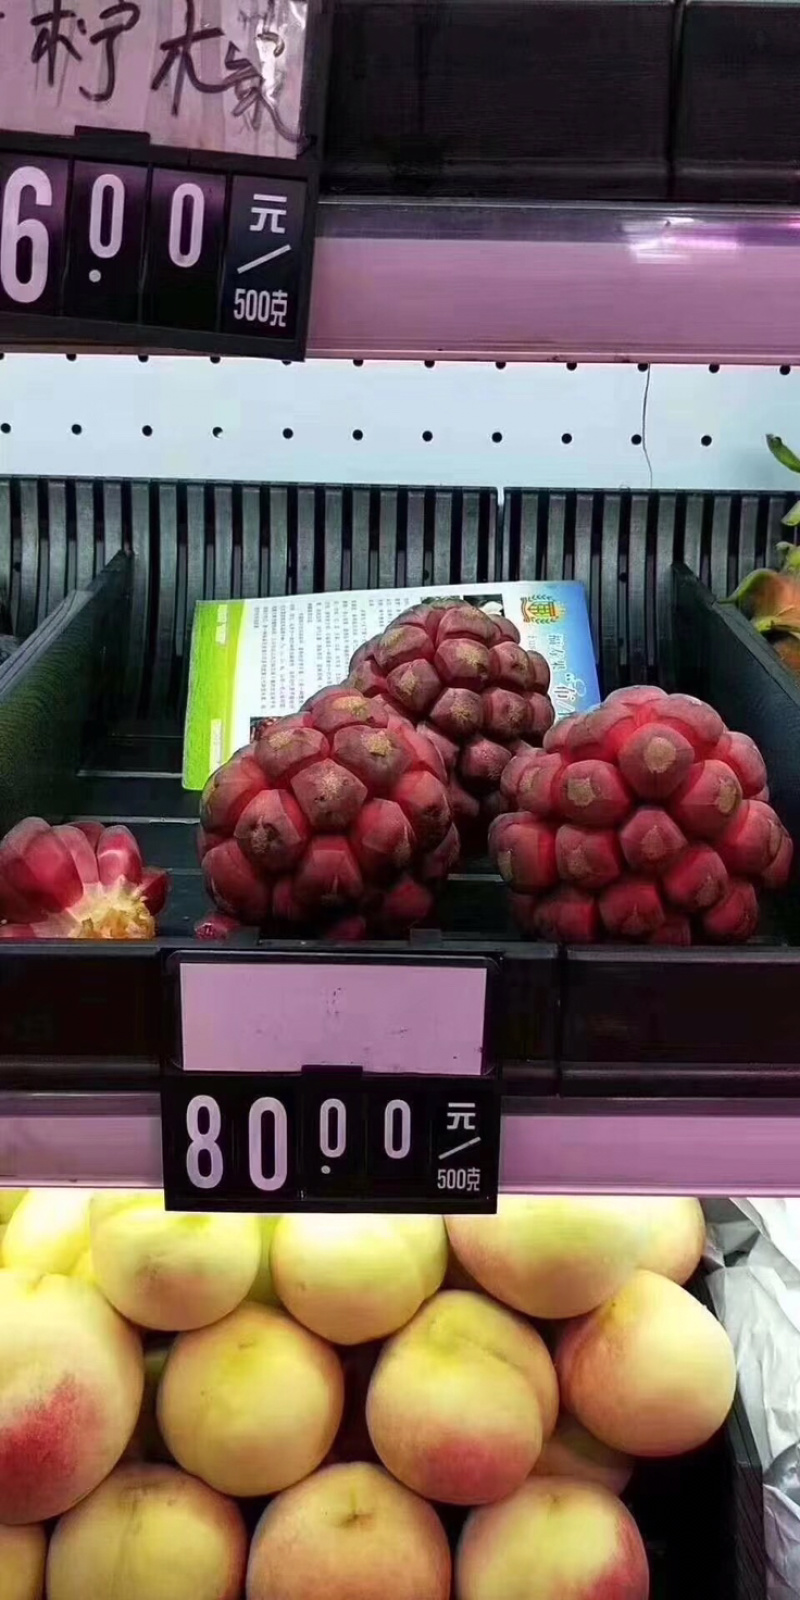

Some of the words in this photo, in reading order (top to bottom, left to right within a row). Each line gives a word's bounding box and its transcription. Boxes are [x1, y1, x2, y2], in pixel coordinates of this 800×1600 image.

[249, 193, 288, 234] 元
[233, 288, 288, 328] 500克
[447, 1102, 476, 1130] 元
[186, 1094, 411, 1191] 80.00
[437, 1168, 480, 1191] 500克
